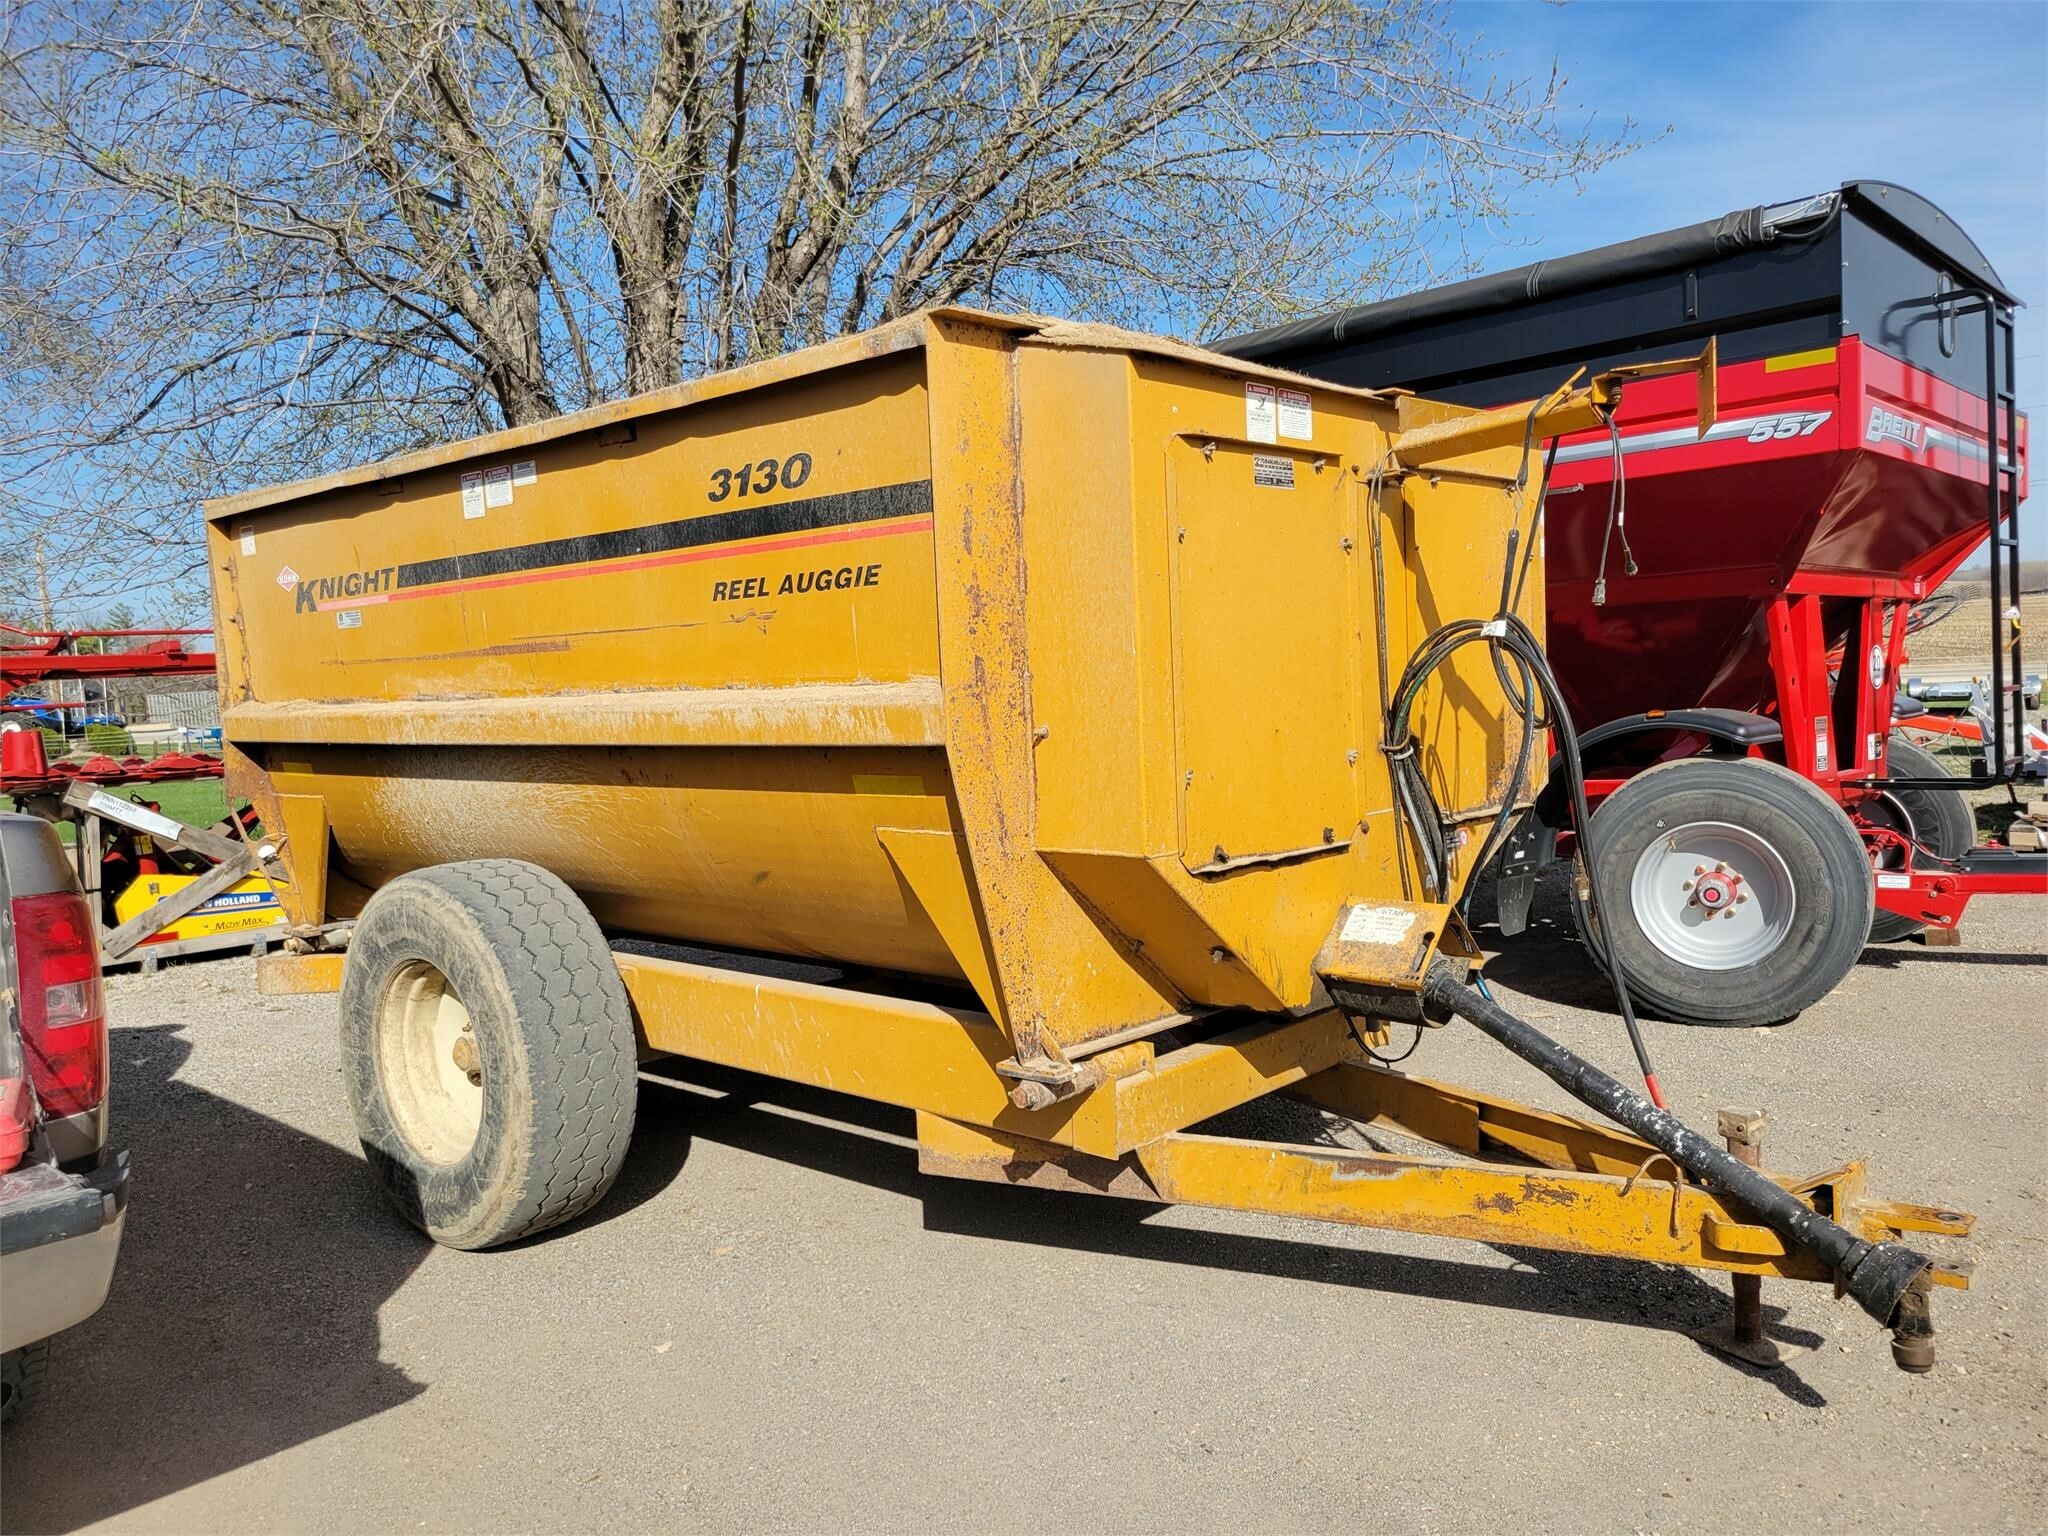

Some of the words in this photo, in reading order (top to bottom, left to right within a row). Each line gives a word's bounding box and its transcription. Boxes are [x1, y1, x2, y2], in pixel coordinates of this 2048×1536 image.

[1747, 411, 1832, 443] 557
[1866, 407, 1921, 445] BRENT
[707, 452, 812, 503] 3130
[295, 567, 395, 614] KNIGHT
[712, 577, 770, 602] REEL
[777, 564, 882, 596] AUGGIE
[214, 894, 261, 907] HOLLAND
